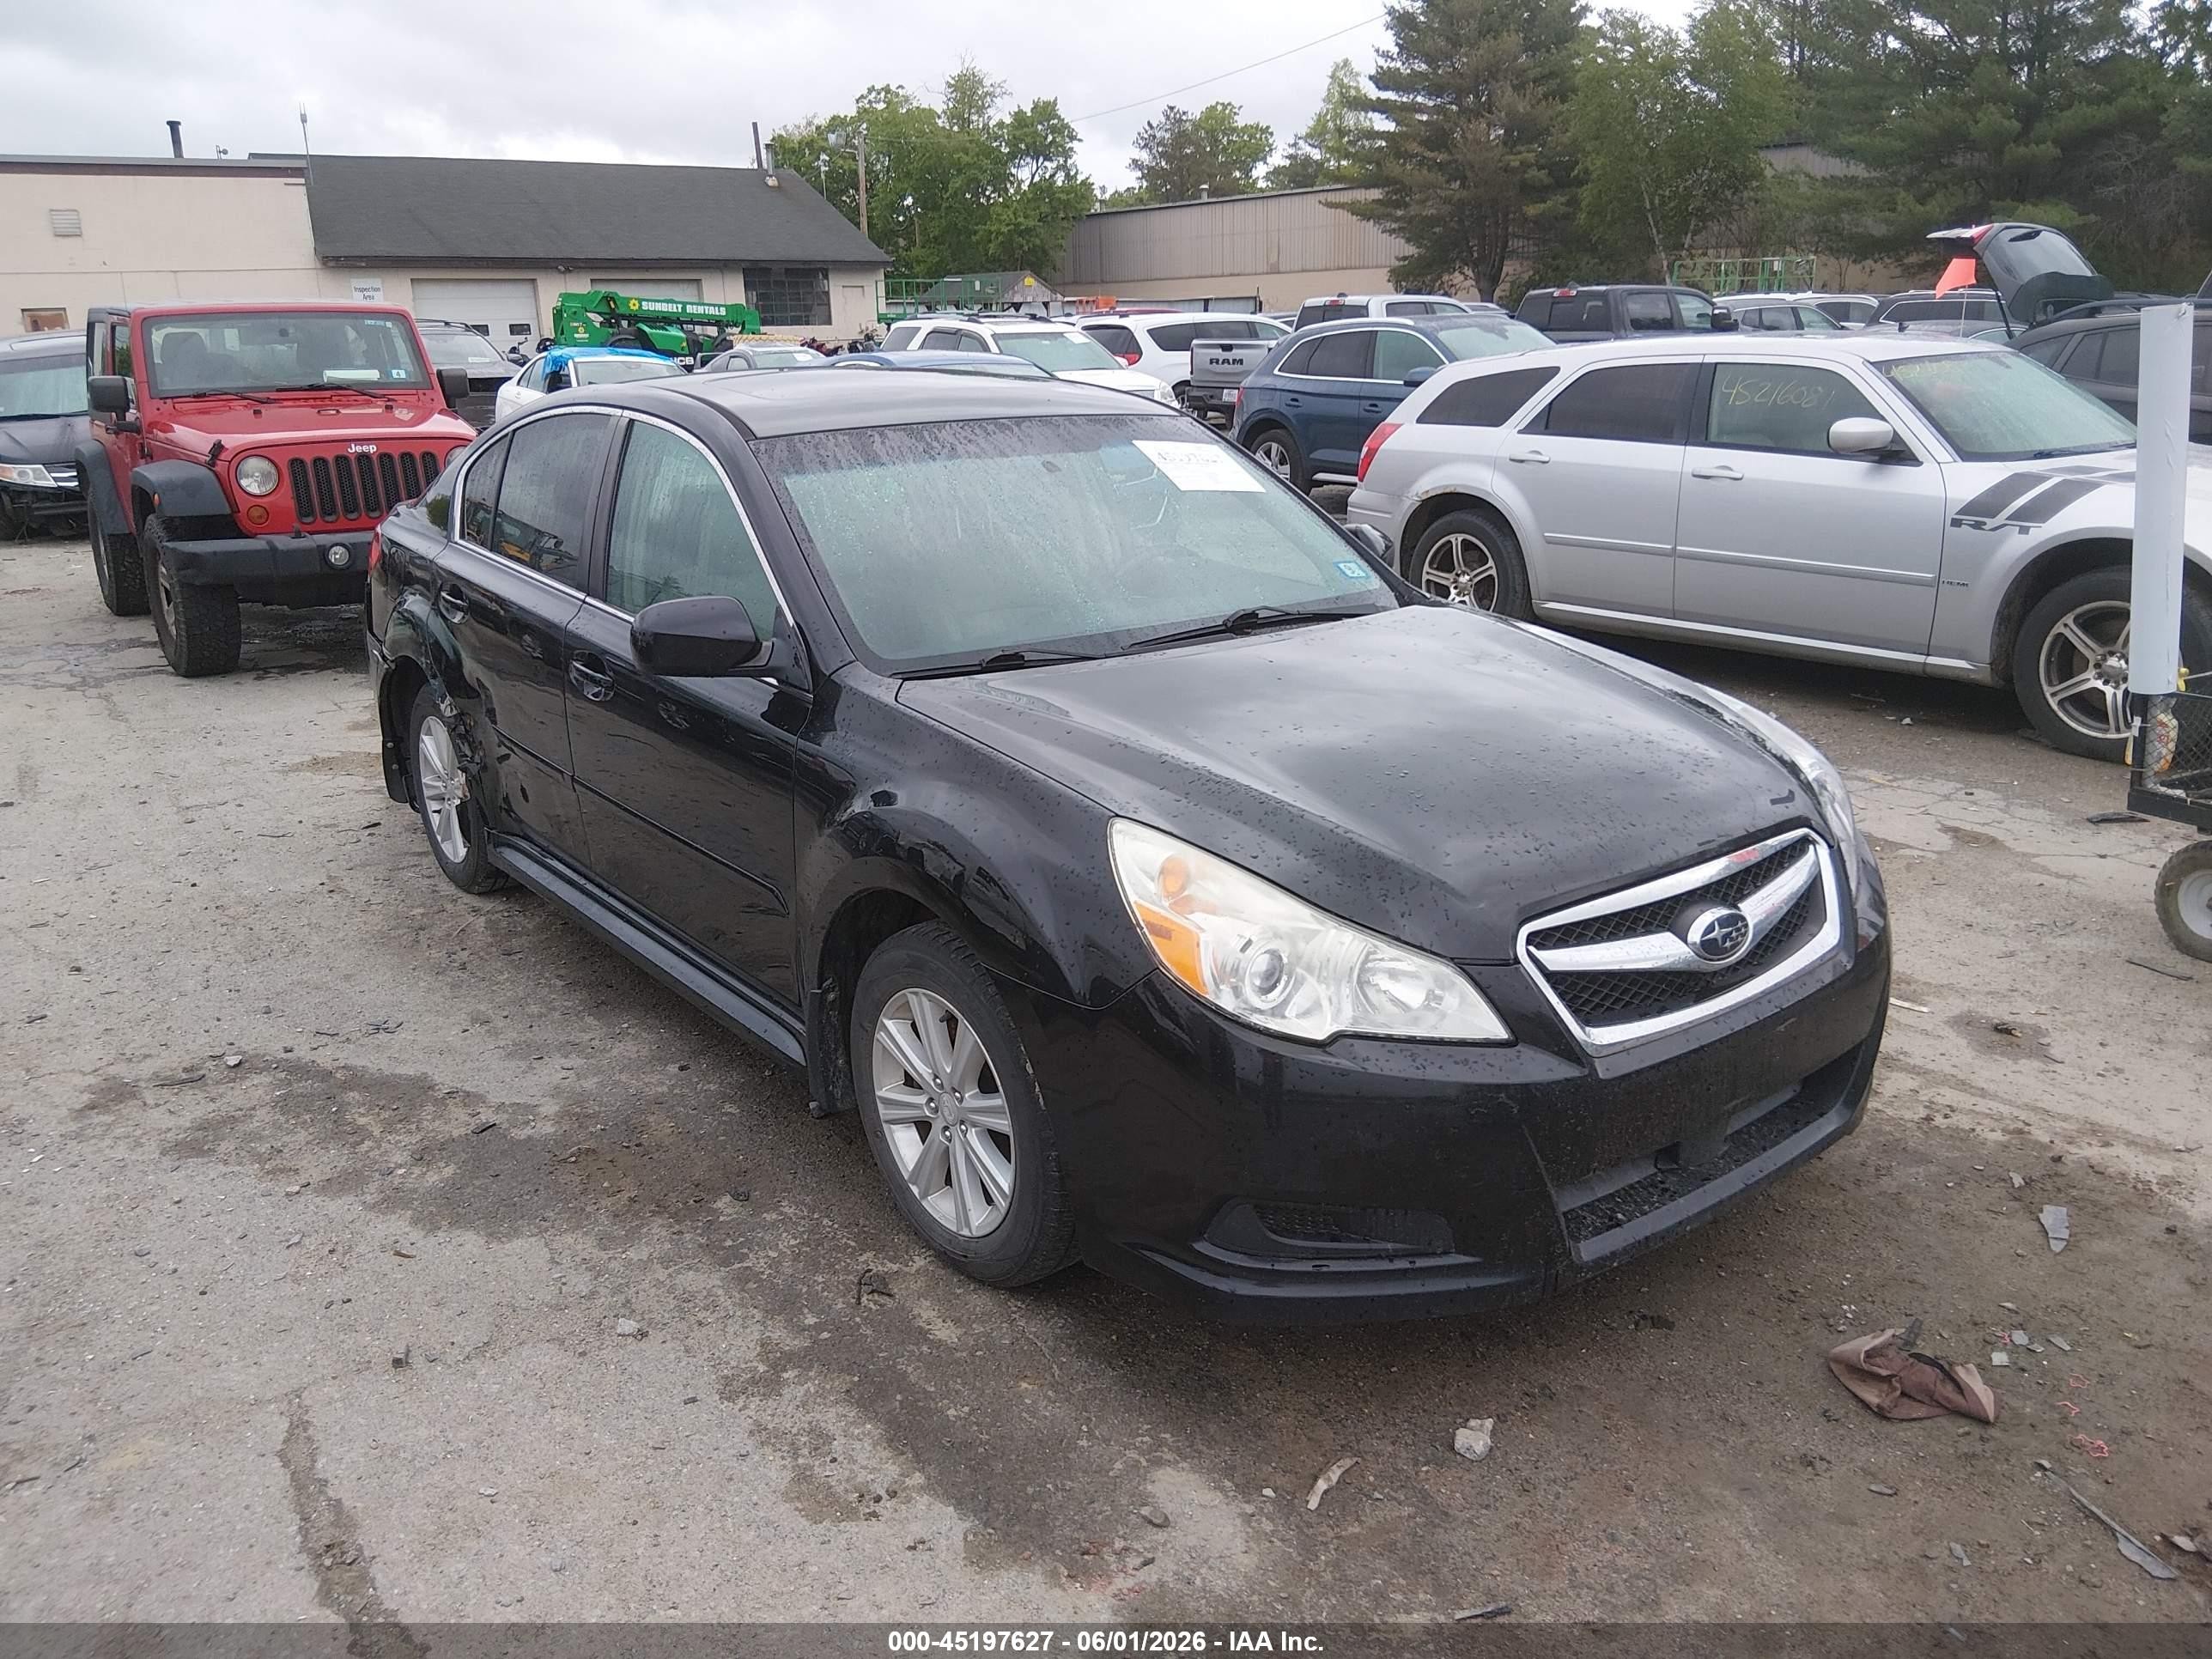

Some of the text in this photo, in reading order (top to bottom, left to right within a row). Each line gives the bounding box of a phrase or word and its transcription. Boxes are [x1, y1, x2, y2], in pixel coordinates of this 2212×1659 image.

[641, 301, 726, 316] SUNBELT RENTALS
[1209, 357, 1244, 366] RAM
[347, 443, 378, 454] Jeep
[1949, 517, 2043, 536] R/T
